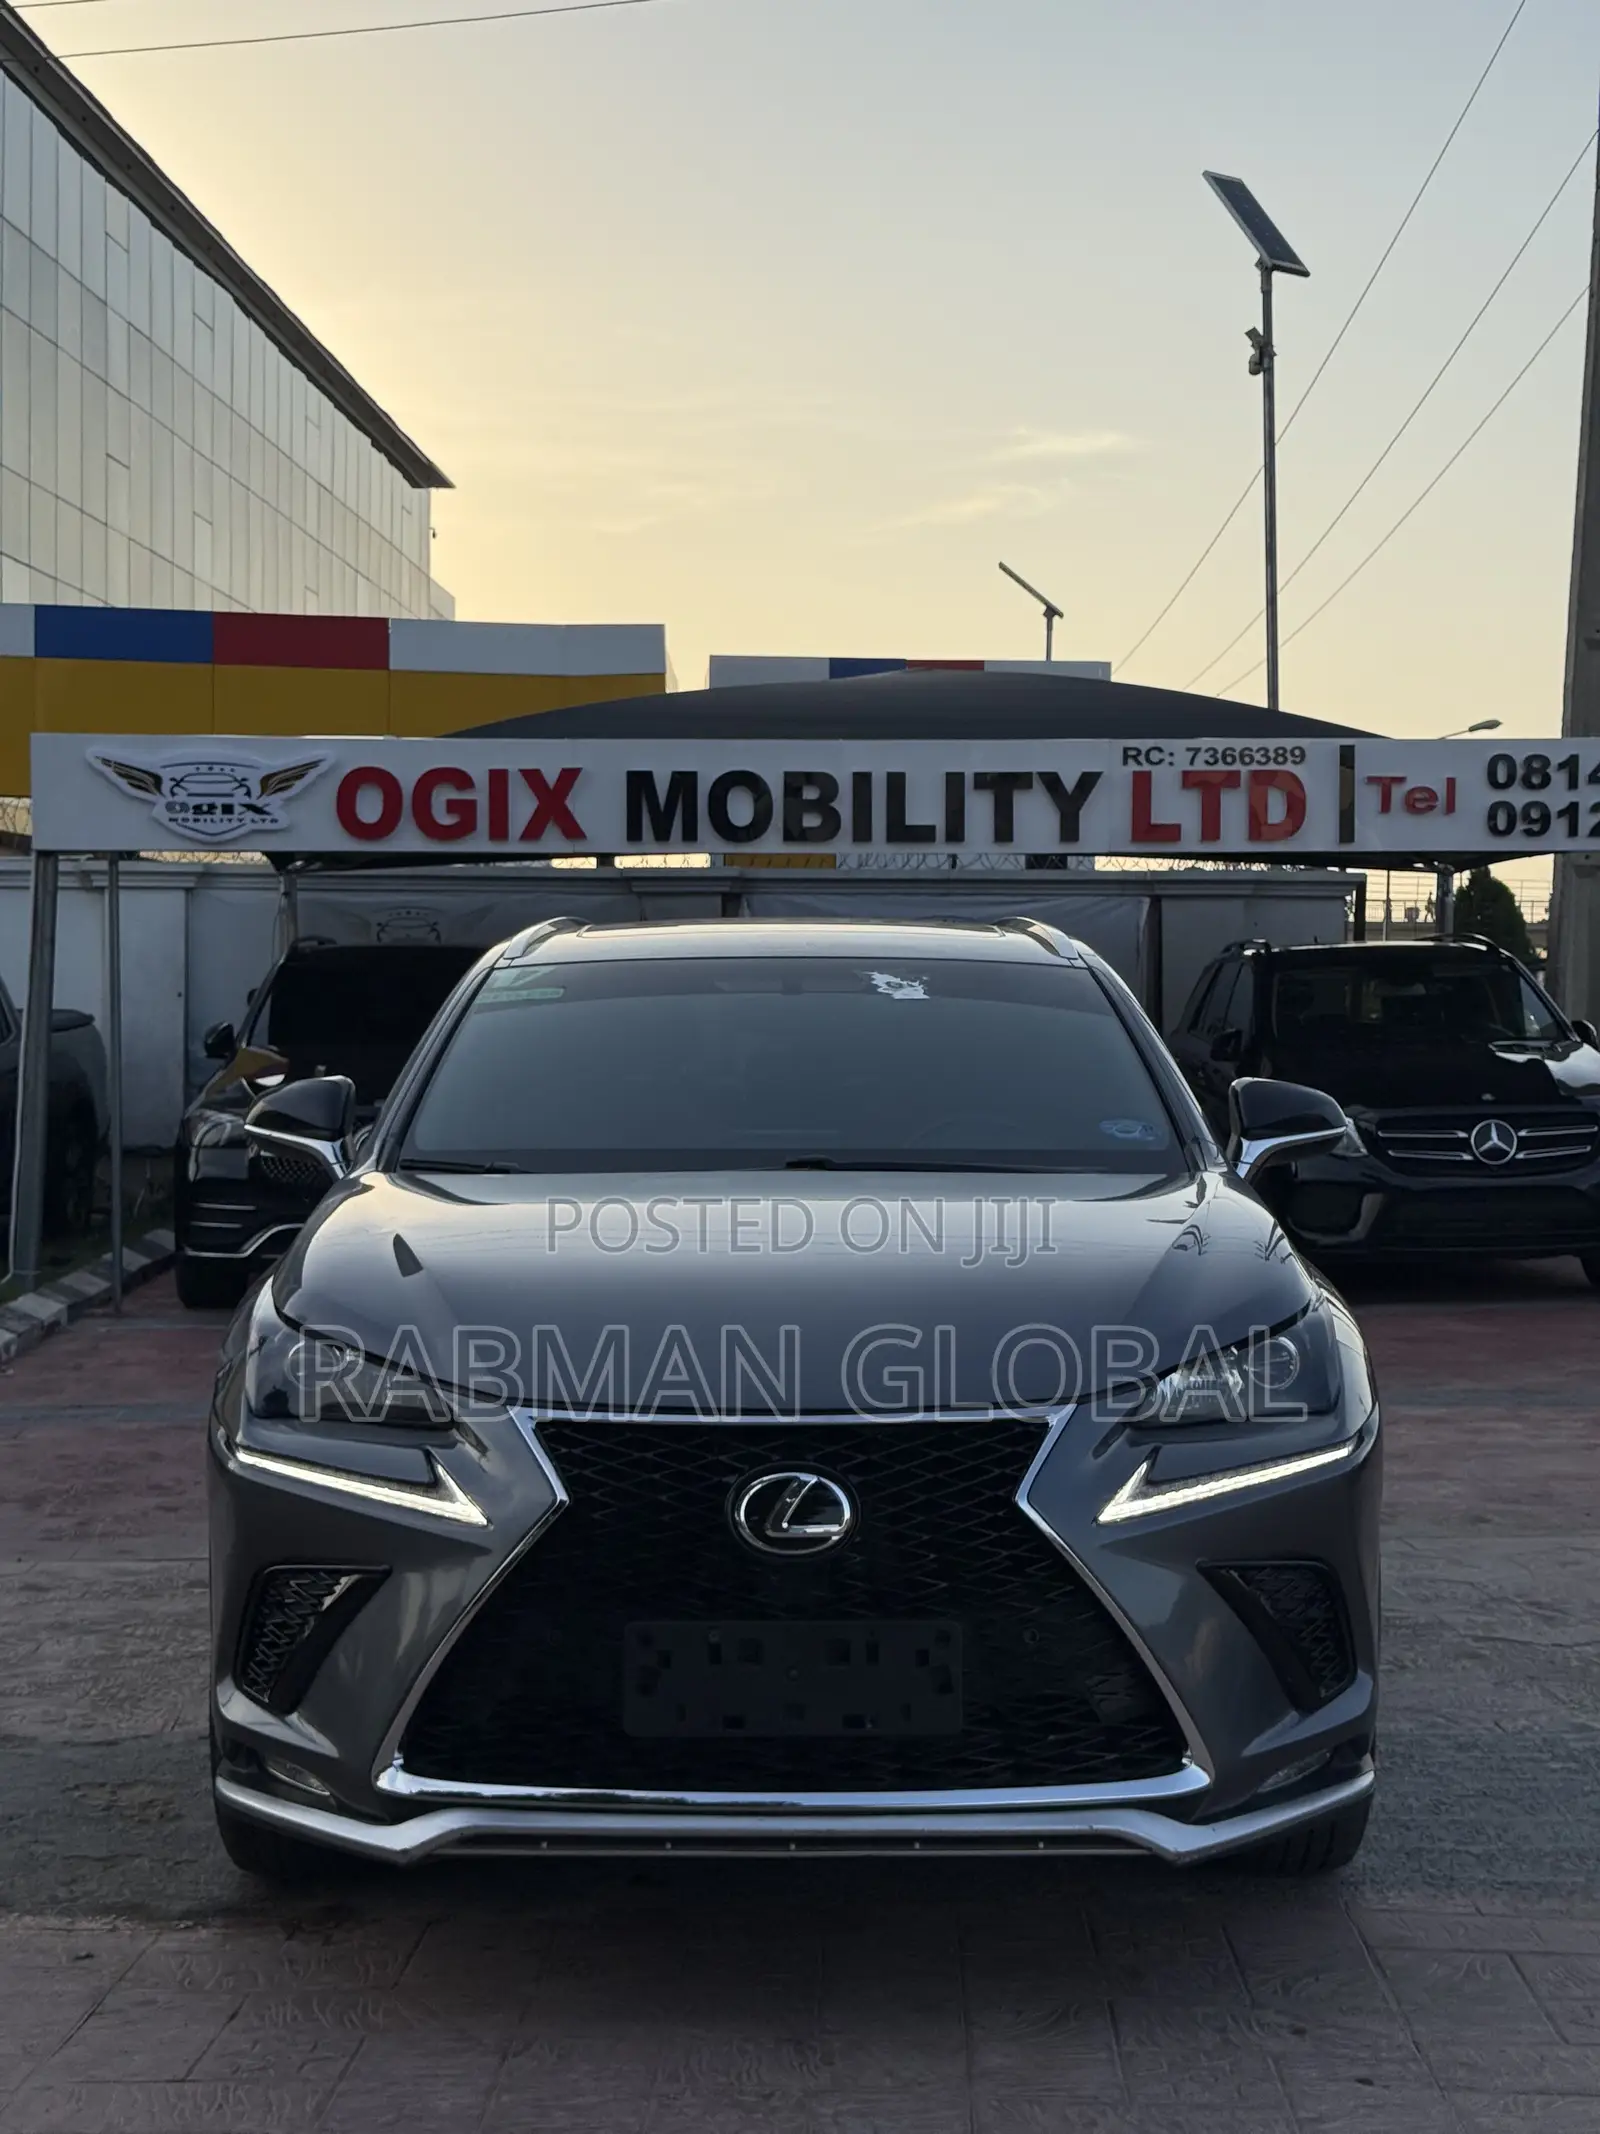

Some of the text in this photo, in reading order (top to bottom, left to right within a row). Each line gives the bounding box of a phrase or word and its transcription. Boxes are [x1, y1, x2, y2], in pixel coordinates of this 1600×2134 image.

[1122, 746, 1306, 766] RC: 7366389
[336, 767, 1307, 843] OGIX MOBILITY LTD
[1367, 775, 1457, 816] Tel
